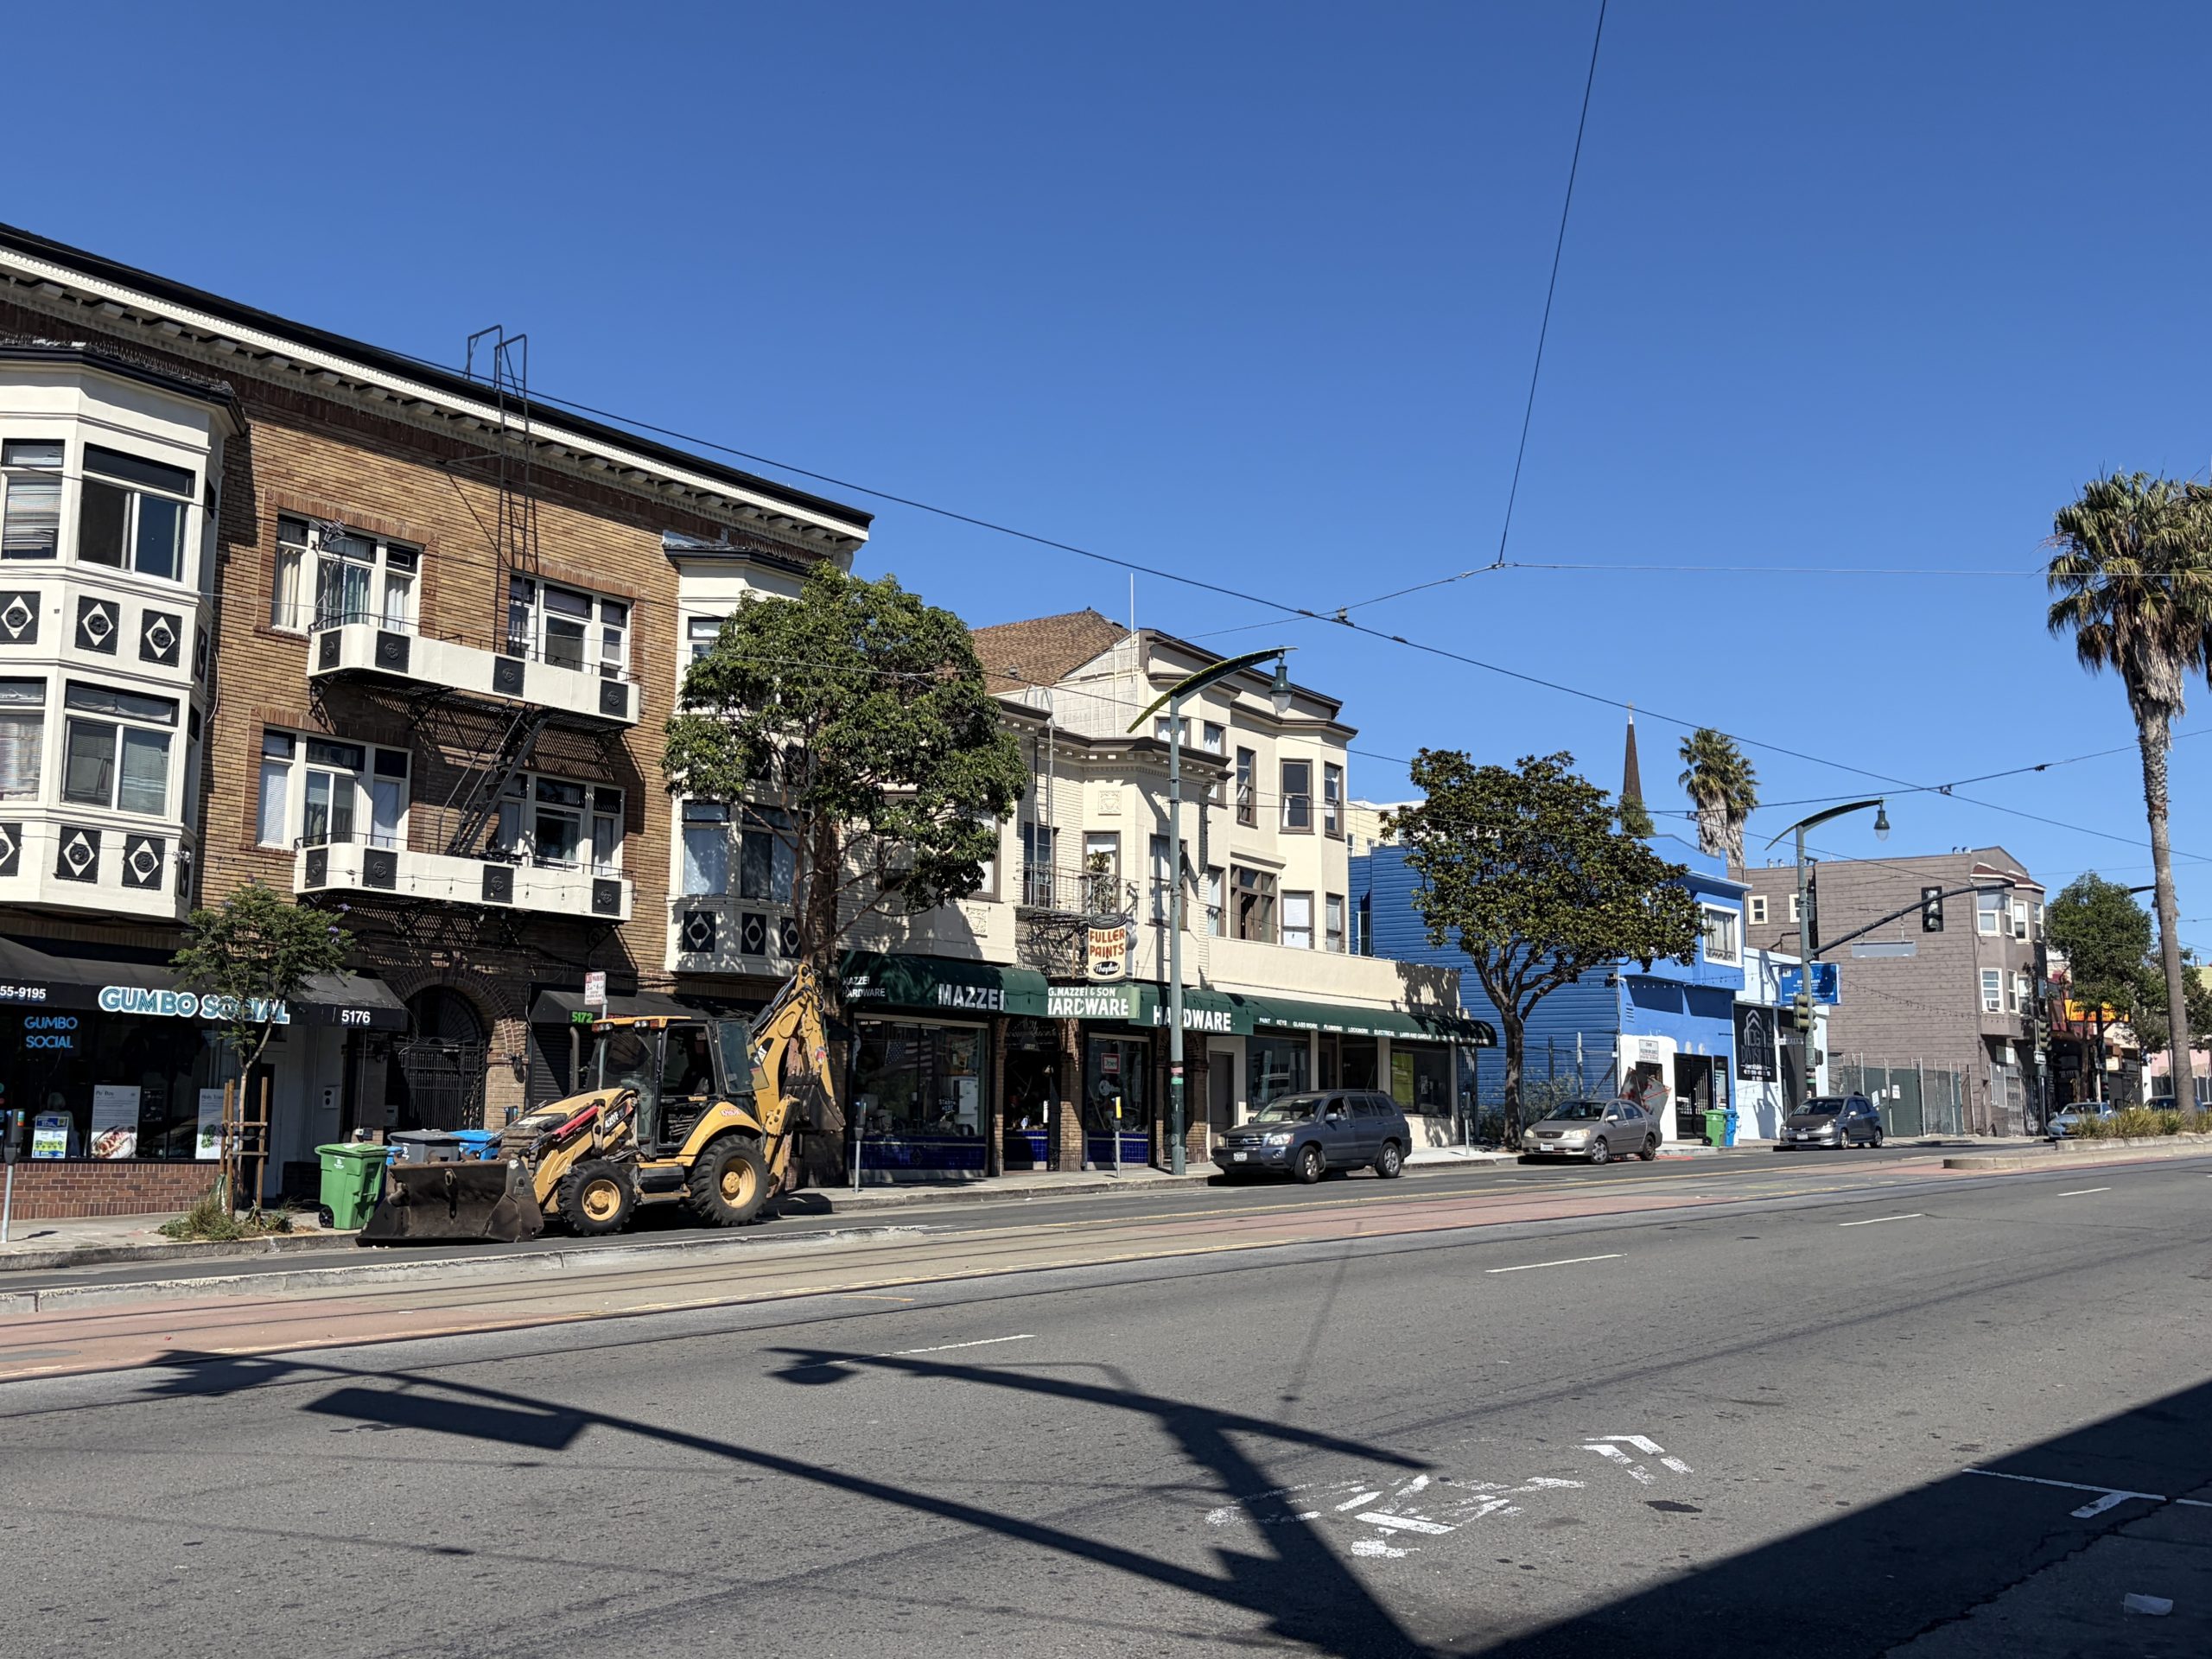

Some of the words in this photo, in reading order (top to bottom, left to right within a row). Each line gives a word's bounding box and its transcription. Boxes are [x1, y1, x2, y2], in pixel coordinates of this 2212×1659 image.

[1090, 929, 1125, 943] FULLER
[1090, 944, 1125, 957] PAINTS
[842, 976, 870, 985] MAZZEI
[842, 988, 886, 997] HARDWARE
[938, 983, 1004, 1011] MAZZEI
[1096, 988, 1116, 996] SON
[99, 986, 199, 1018] GUMBO
[24, 1016, 78, 1029] GUMBO
[341, 1010, 371, 1023] 5176
[572, 1011, 593, 1023] 5172
[1154, 1005, 1231, 1032] HADWARE
[26, 1036, 73, 1048] SOCIAL
